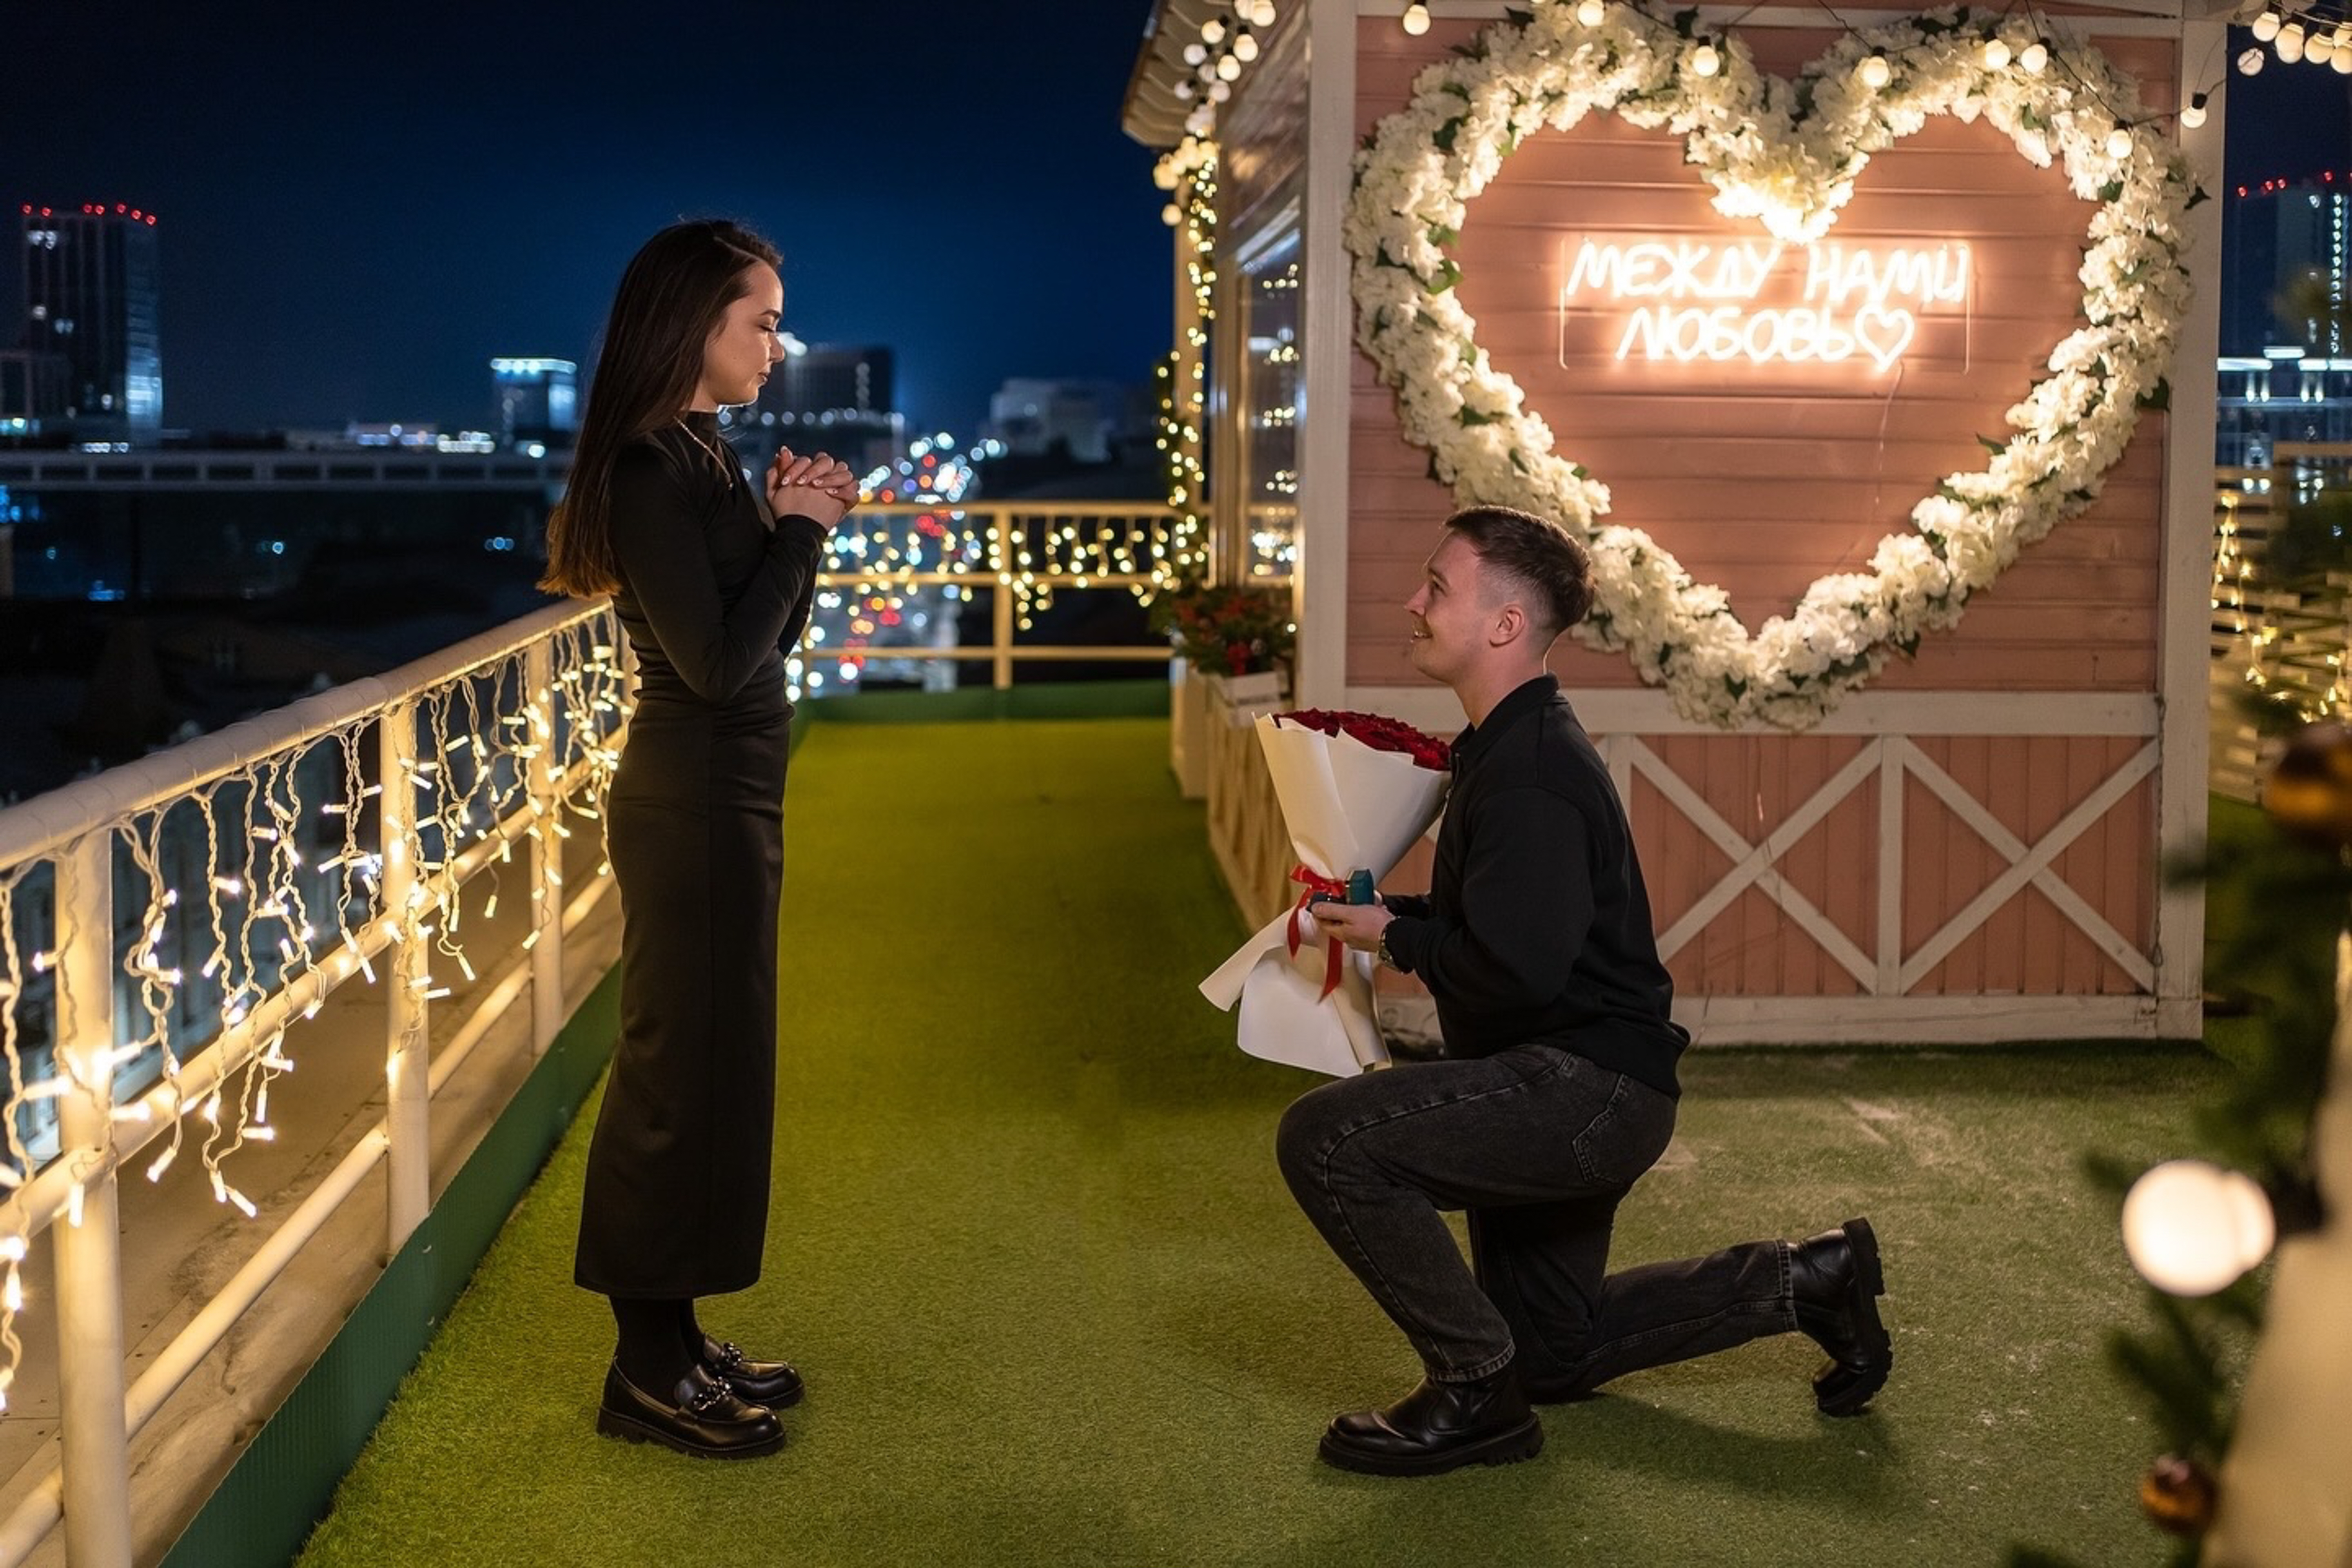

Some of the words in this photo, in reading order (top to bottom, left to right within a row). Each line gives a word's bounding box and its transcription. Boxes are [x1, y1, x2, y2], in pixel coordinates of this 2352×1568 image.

[1566, 241, 1782, 298] МЕЖДУ
[1804, 242, 1968, 303] НАМИ
[1615, 307, 1856, 363] ЛЮБОВЬ
